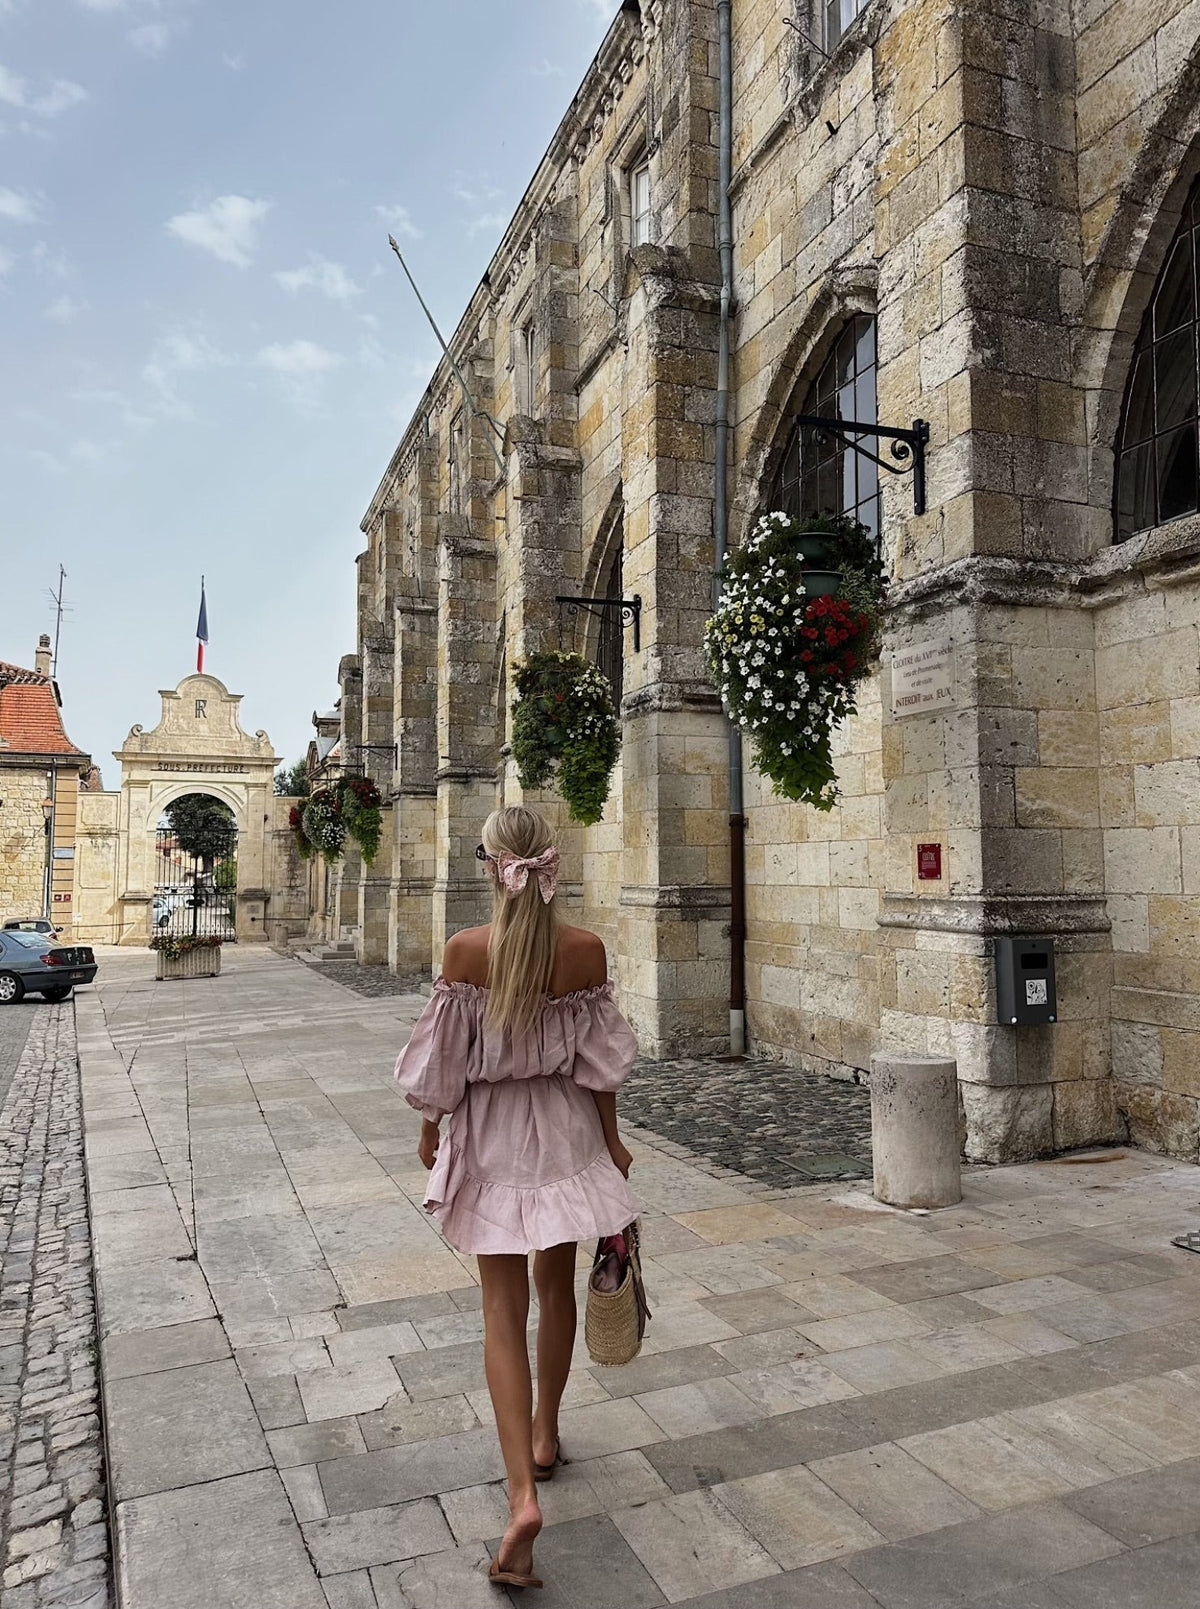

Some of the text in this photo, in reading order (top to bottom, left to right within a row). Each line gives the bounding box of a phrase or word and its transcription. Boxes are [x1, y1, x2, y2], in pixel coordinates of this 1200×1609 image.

[896, 687, 951, 707] INTERDIT aux JEUX
[158, 762, 180, 771] SOUS
